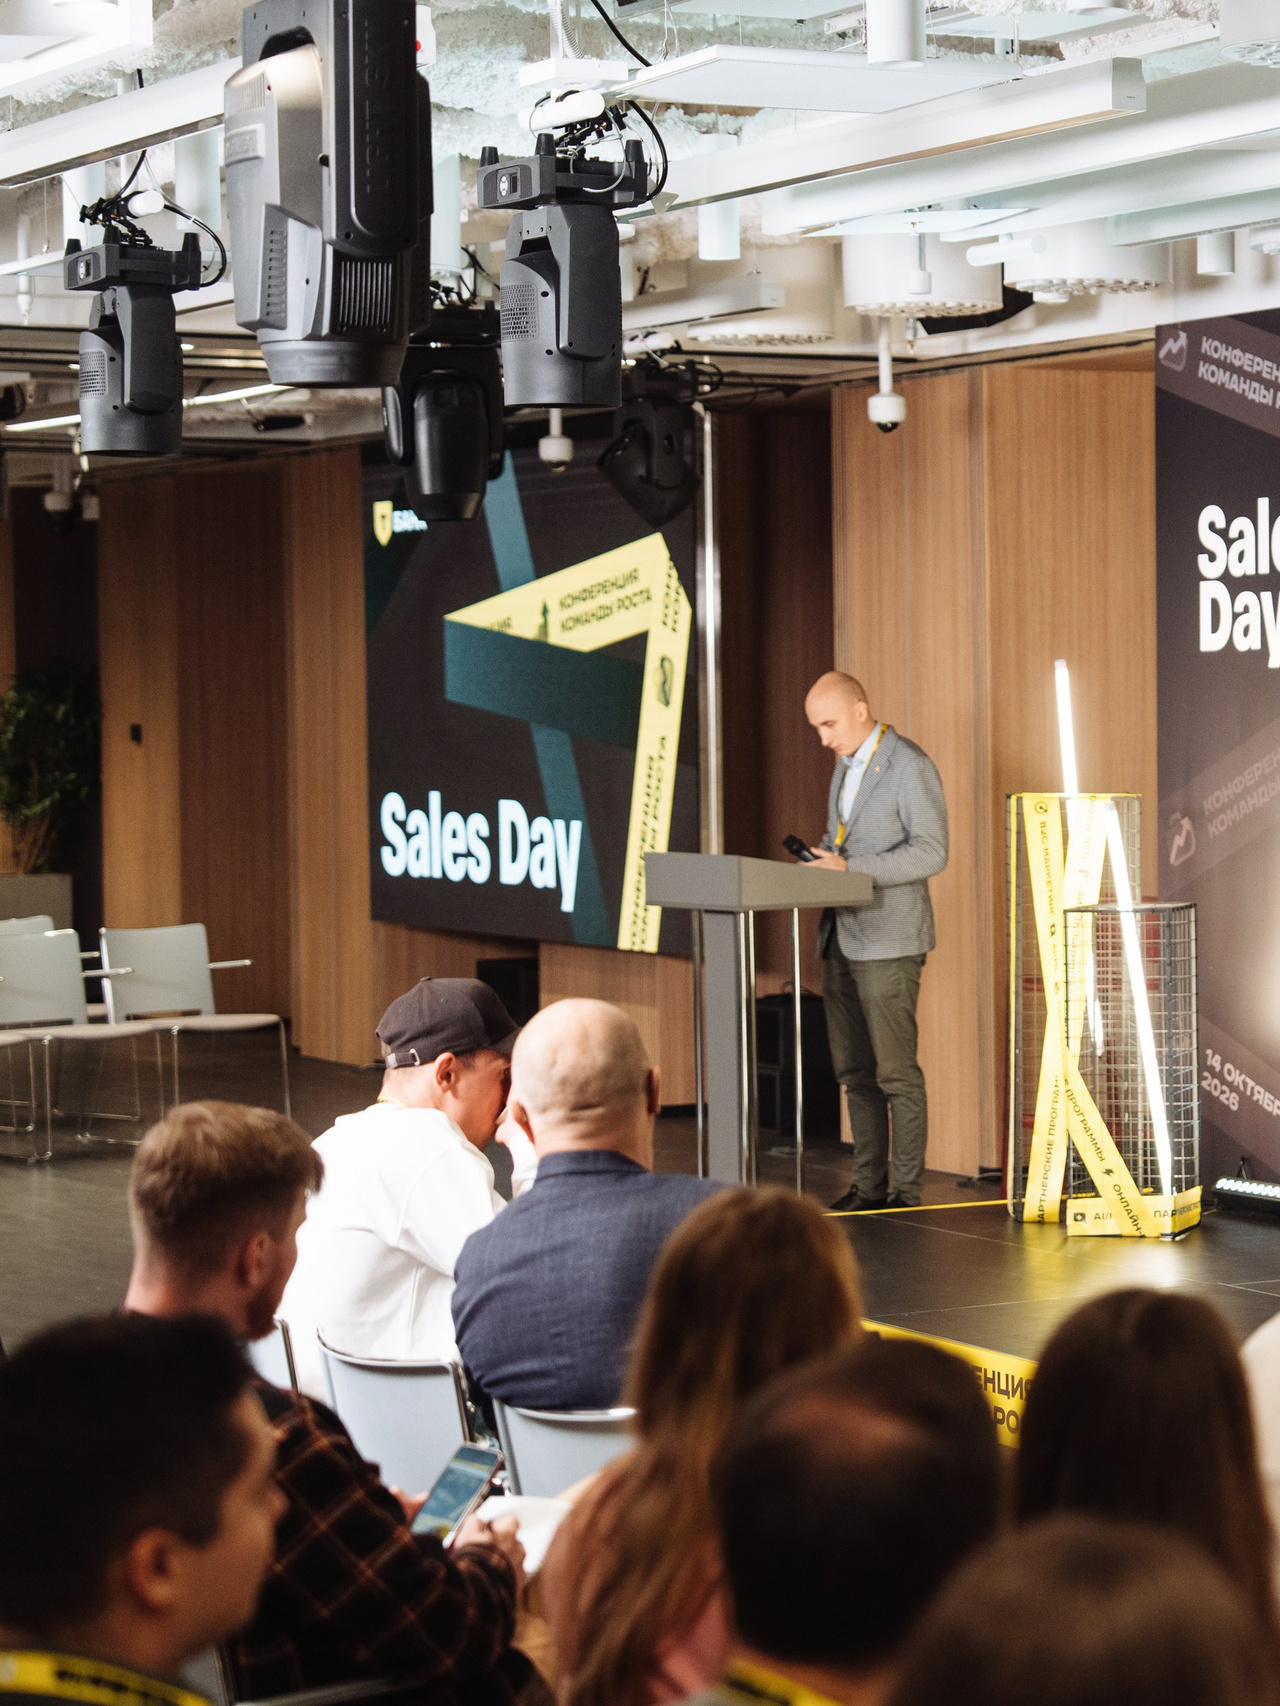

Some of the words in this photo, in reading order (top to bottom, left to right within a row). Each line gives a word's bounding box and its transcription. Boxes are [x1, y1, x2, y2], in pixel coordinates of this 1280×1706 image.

[1198, 361, 1274, 407] КОМАНДЫ
[559, 567, 640, 610] КОНФЕРЕНЦИЯ
[560, 602, 614, 634] КОМАНДЫ
[616, 588, 653, 611] РОСТА
[380, 789, 492, 885] Sales
[498, 798, 583, 913] Day
[1205, 1048, 1222, 1073] 14
[1201, 1071, 1240, 1112] 2026
[1065, 1088, 1106, 1163] ПРОГРАММЫ
[1112, 1183, 1147, 1238] ОНЛАЙН-
